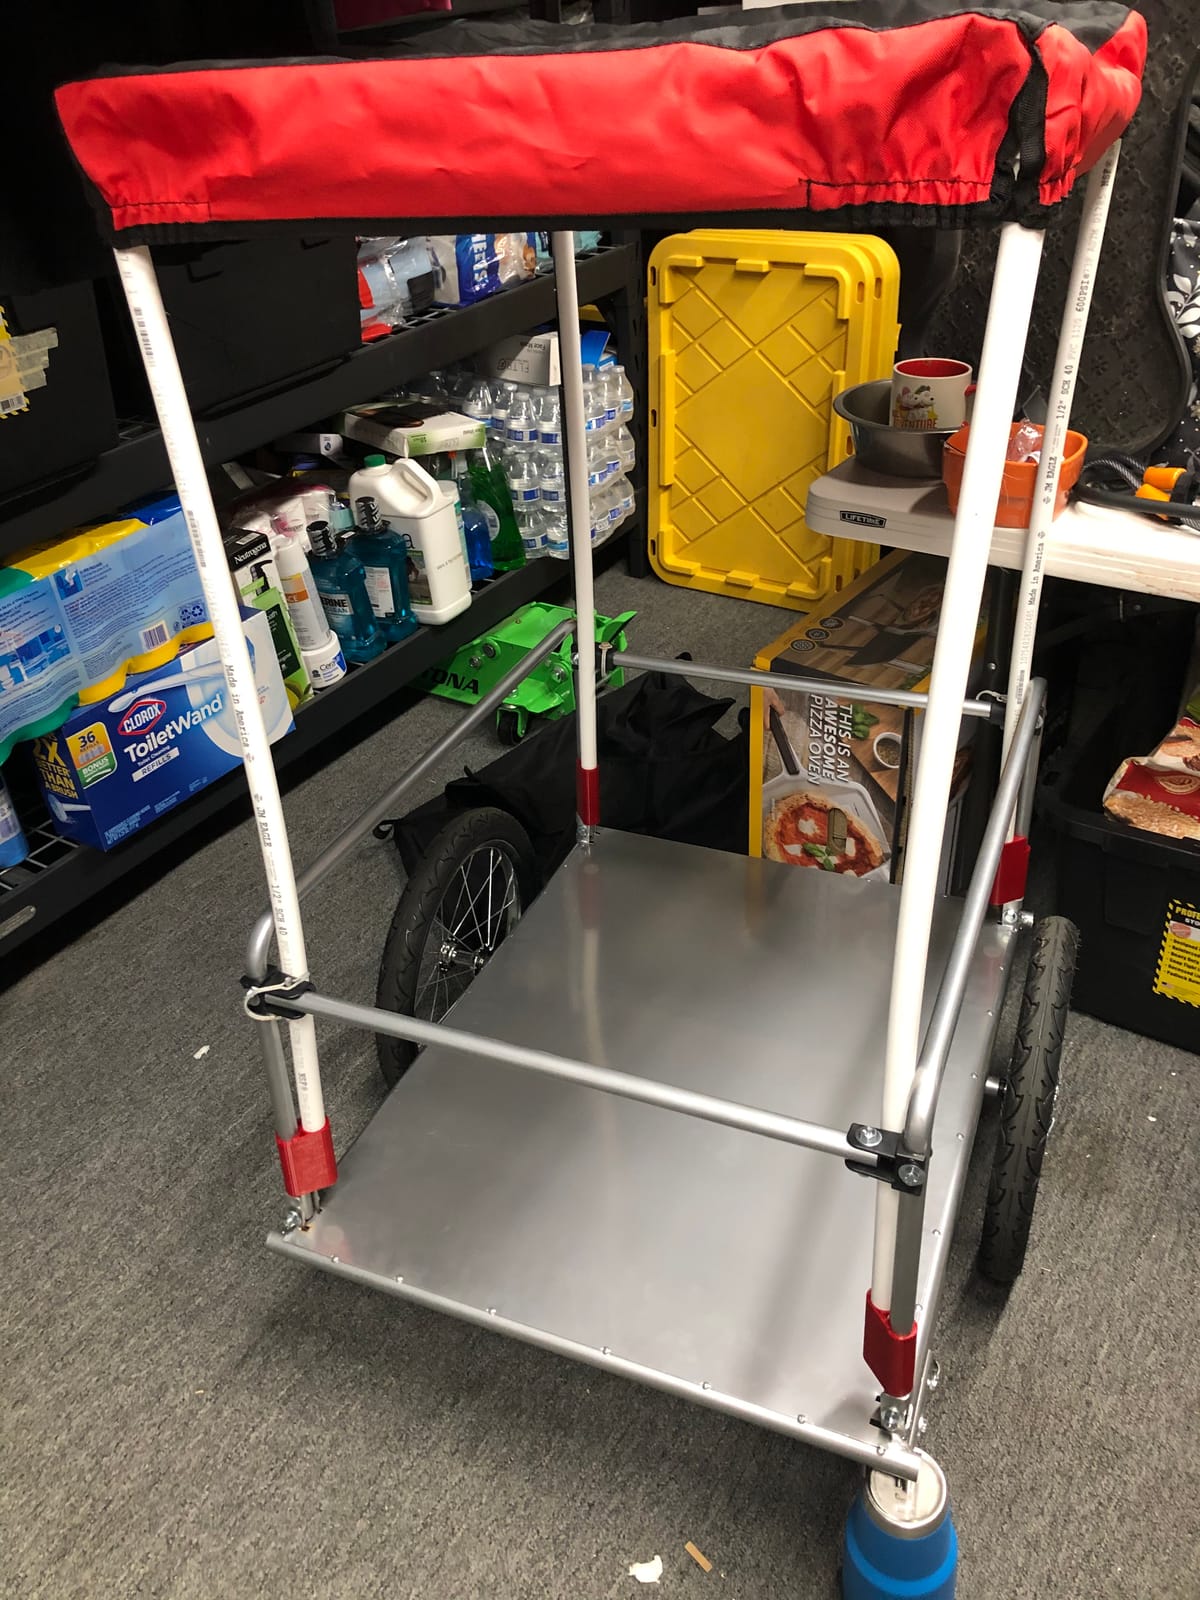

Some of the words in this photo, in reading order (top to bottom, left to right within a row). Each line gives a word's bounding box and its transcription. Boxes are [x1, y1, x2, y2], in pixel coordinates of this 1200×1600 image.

[1064, 365, 1073, 375] 40
[1061, 380, 1071, 395] SCH
[1046, 456, 1058, 480] EAGLE
[845, 512, 881, 525] LIFETIME
[233, 542, 267, 564] Neutrogena
[1033, 543, 1044, 573] America
[1031, 574, 1039, 586] in
[1028, 588, 1037, 606] Made
[225, 664, 237, 688] Made
[232, 693, 240, 704] in
[123, 703, 161, 733] CLOROX
[809, 694, 824, 738] PIZZA
[838, 704, 853, 739] THIS
[124, 693, 223, 762] ToiletWand
[235, 709, 250, 748] America
[78, 731, 96, 748] 36
[822, 697, 838, 781] AWESOME
[837, 741, 851, 757] IS
[82, 756, 109, 775] BONUS
[142, 754, 172, 775] REFILLS
[807, 742, 822, 785] OVEN
[836, 758, 850, 783] AN
[40, 768, 76, 790] THAN
[259, 821, 272, 848] EAGLE
[275, 907, 285, 923] SCH
[279, 927, 288, 936] 40
